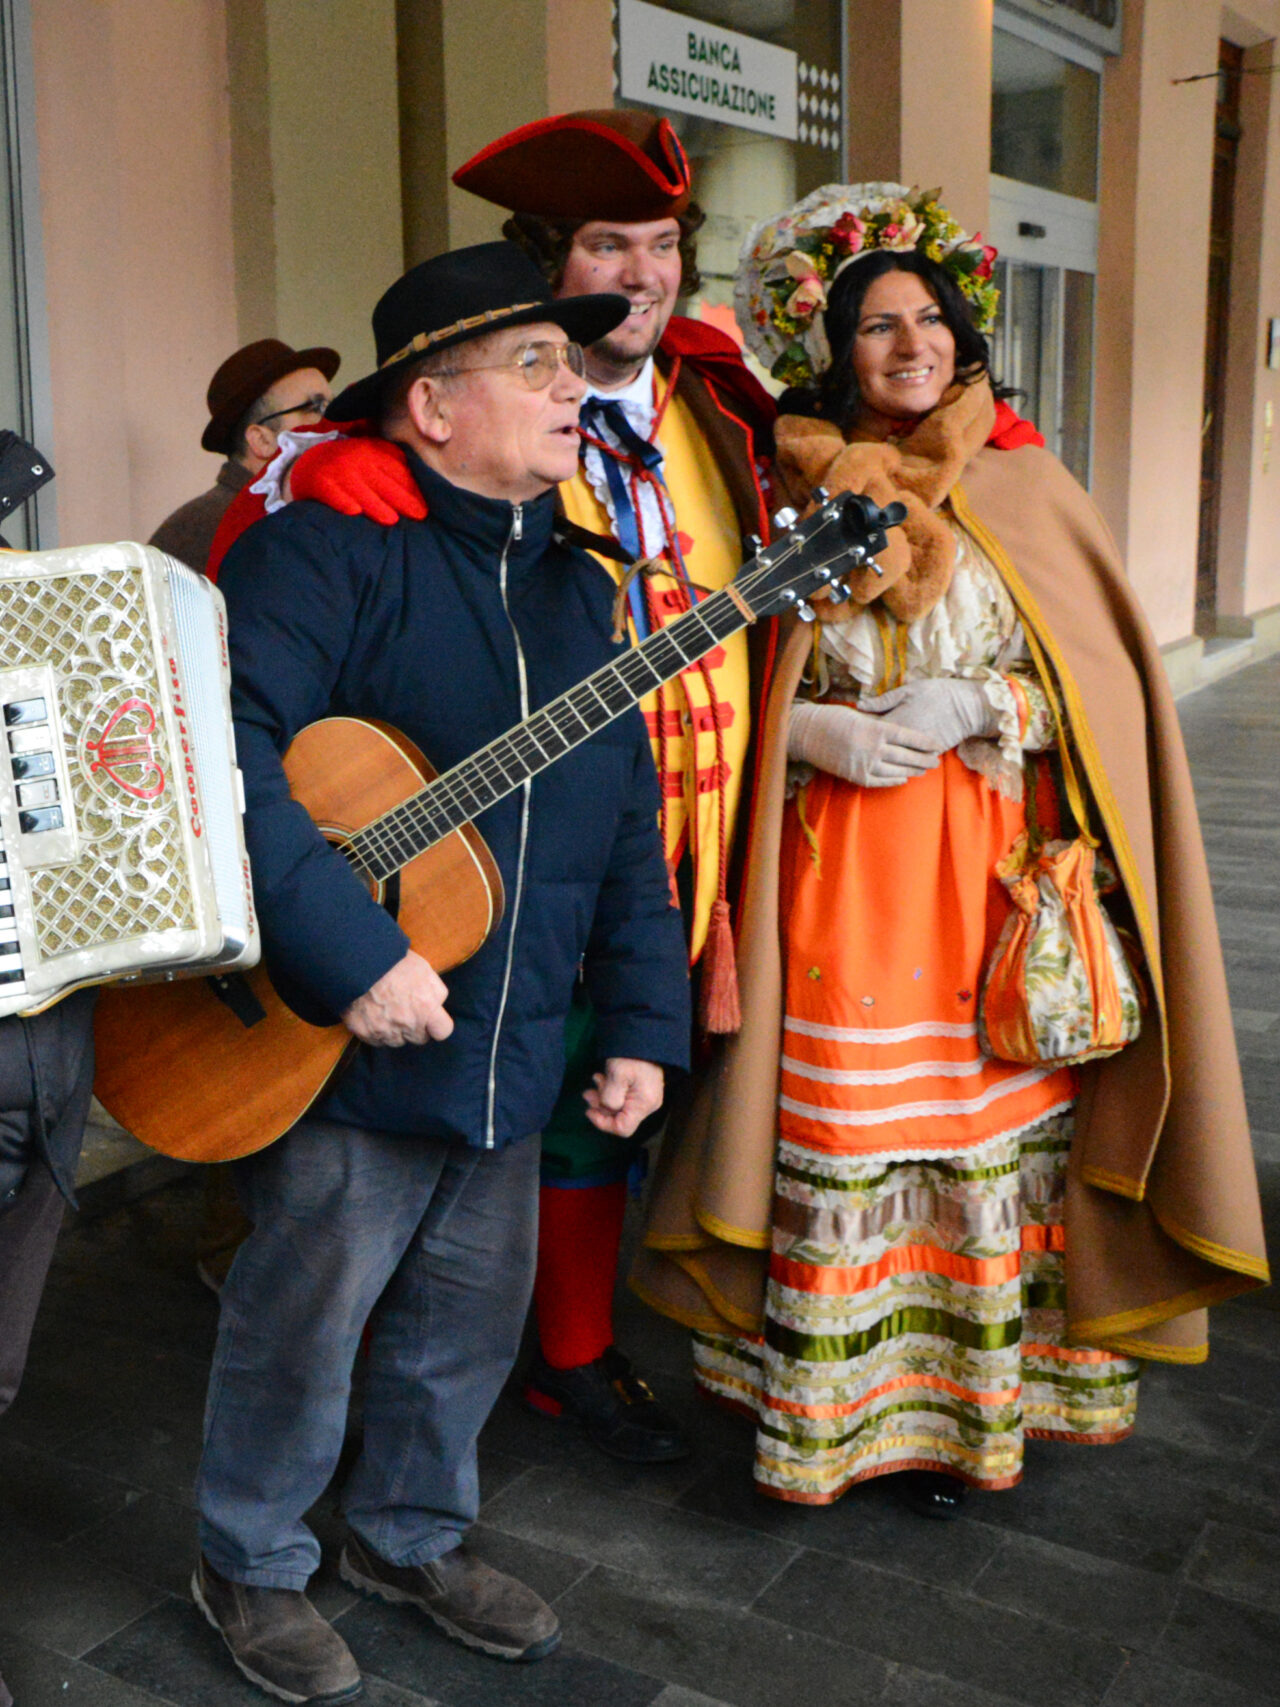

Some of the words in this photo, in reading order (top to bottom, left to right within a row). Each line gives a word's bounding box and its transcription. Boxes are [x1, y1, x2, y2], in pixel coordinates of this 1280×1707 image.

[687, 31, 741, 74] BANCA
[646, 61, 776, 121] ASSICURAZIONE
[168, 658, 202, 838] Cooperfisa
